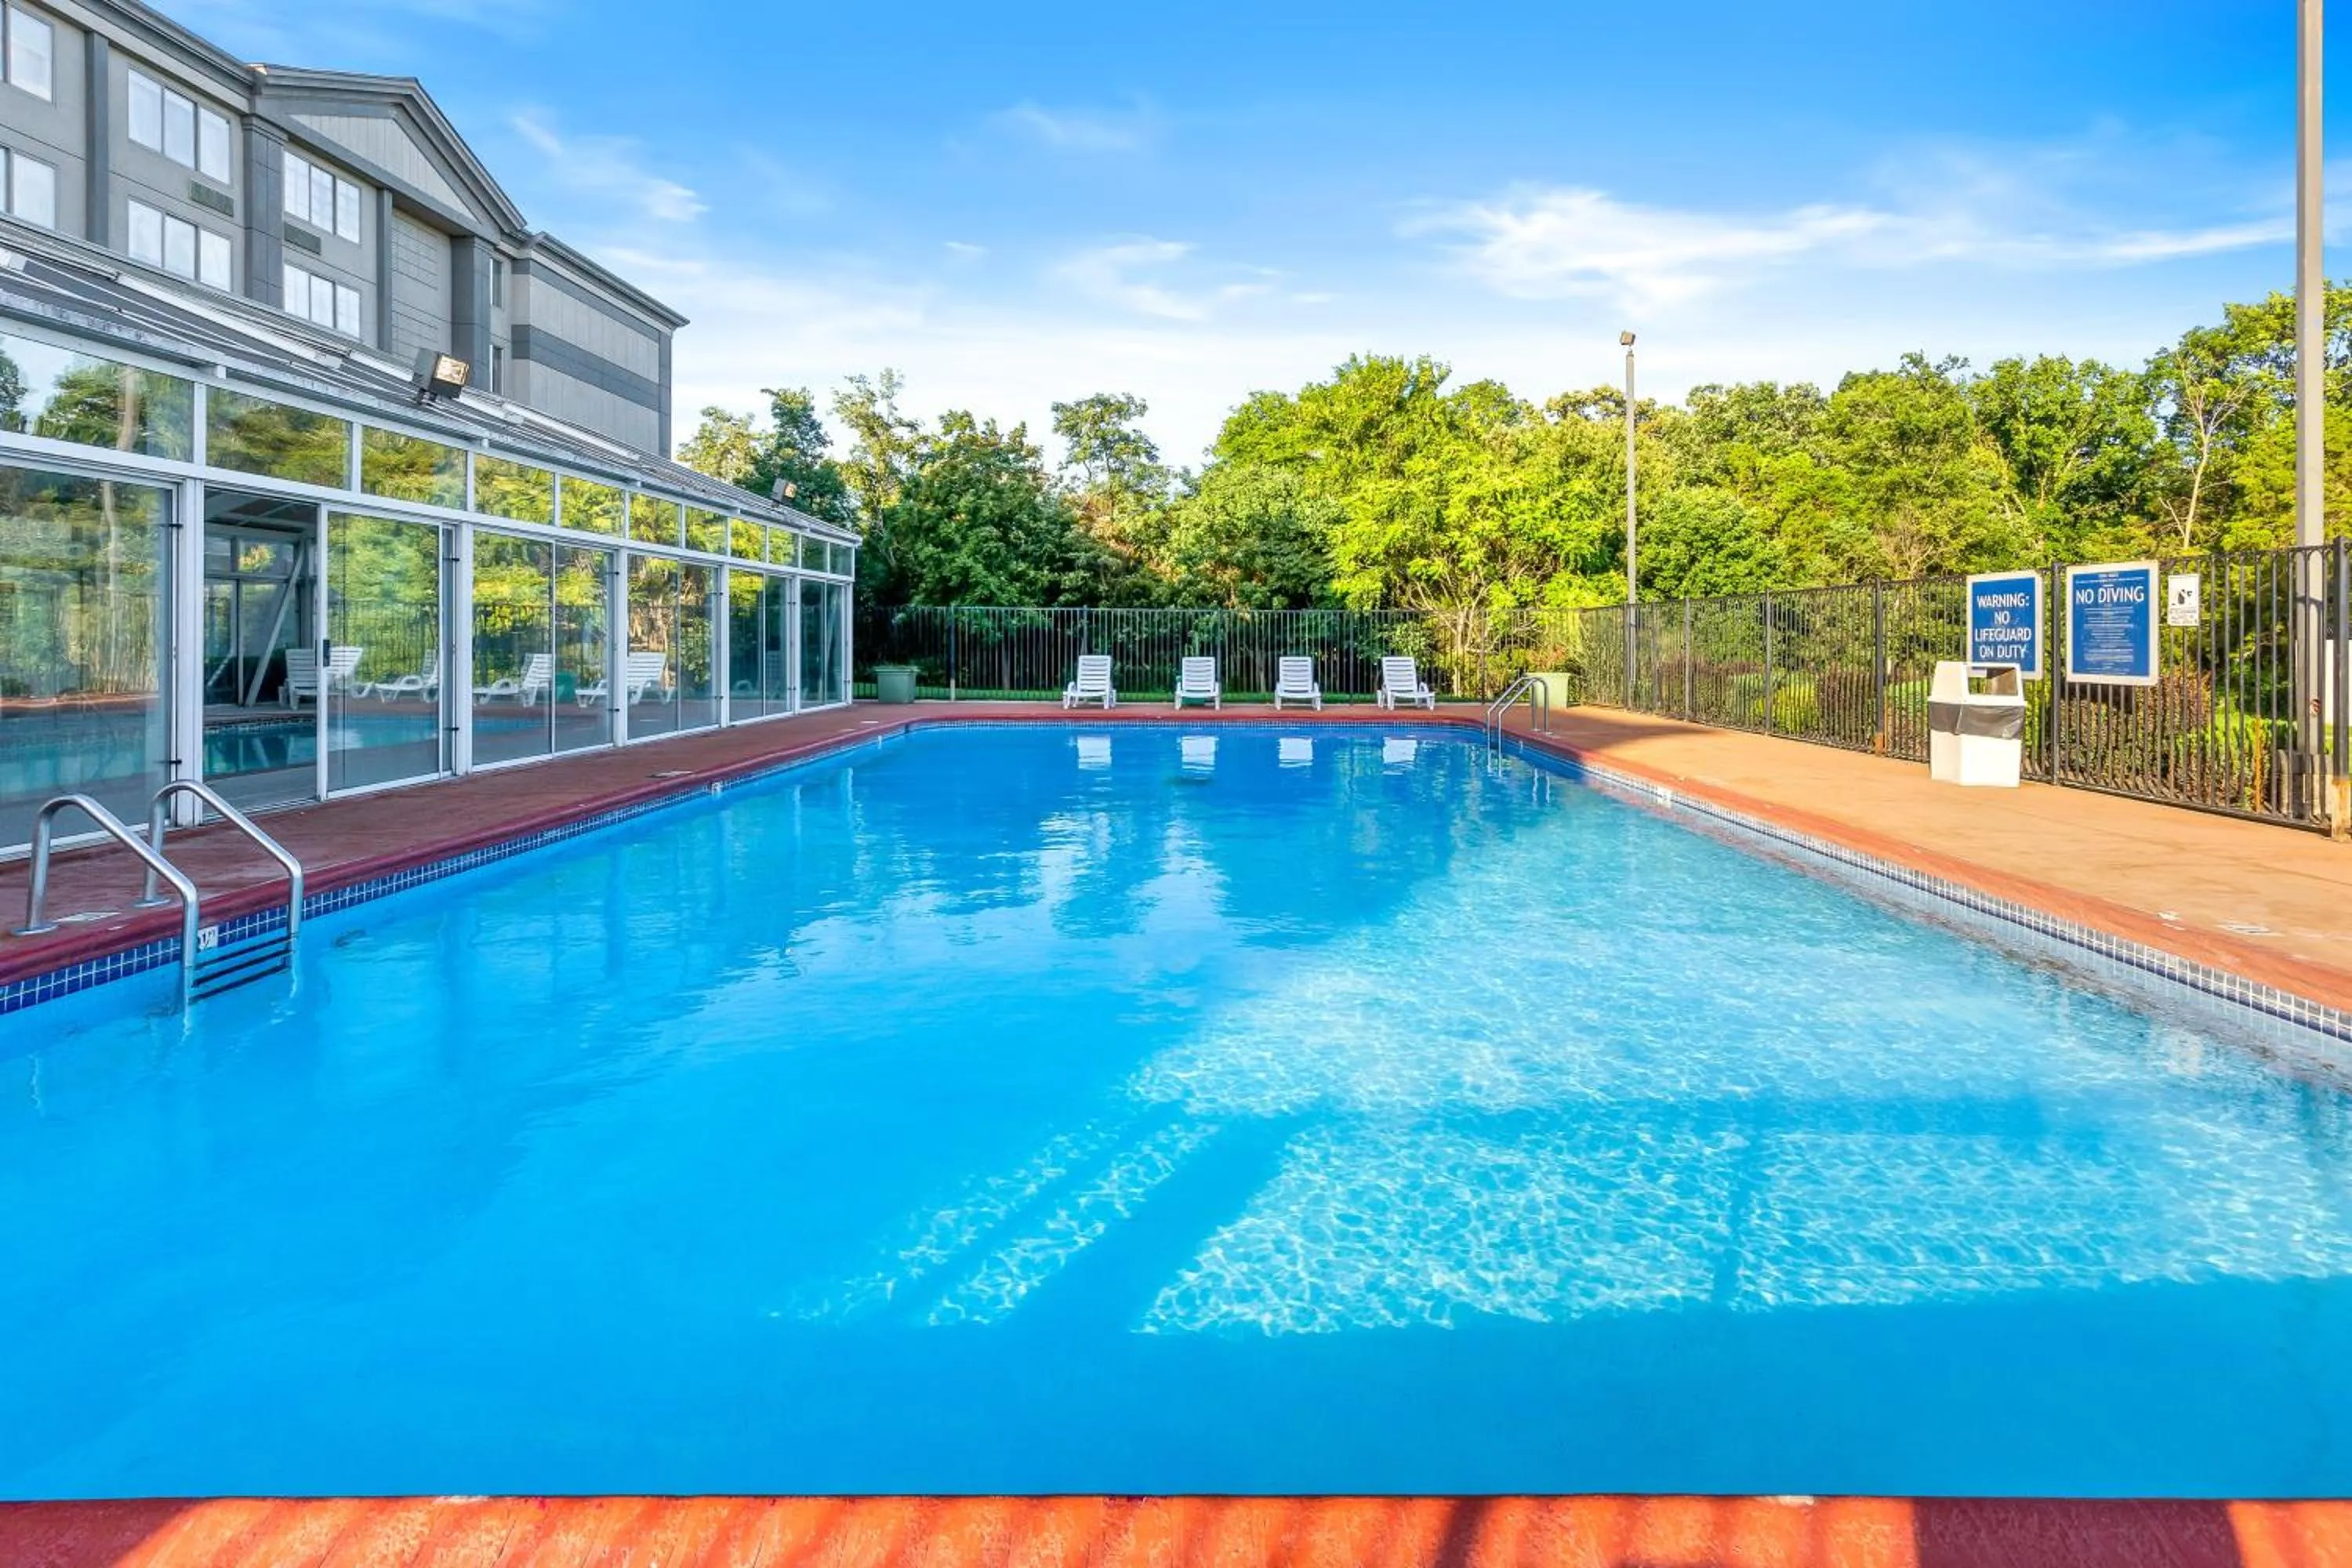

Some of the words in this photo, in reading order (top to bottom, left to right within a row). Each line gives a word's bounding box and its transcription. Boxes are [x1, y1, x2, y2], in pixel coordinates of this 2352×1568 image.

[1976, 593, 2030, 608] WARNING:
[2075, 589, 2094, 604] NO
[2098, 586, 2144, 603] DIVING
[1994, 611, 2010, 624] NO
[1975, 627, 2031, 642] LIFEGUARD
[1979, 644, 1994, 659] ON
[1997, 644, 2027, 659] DUTY
